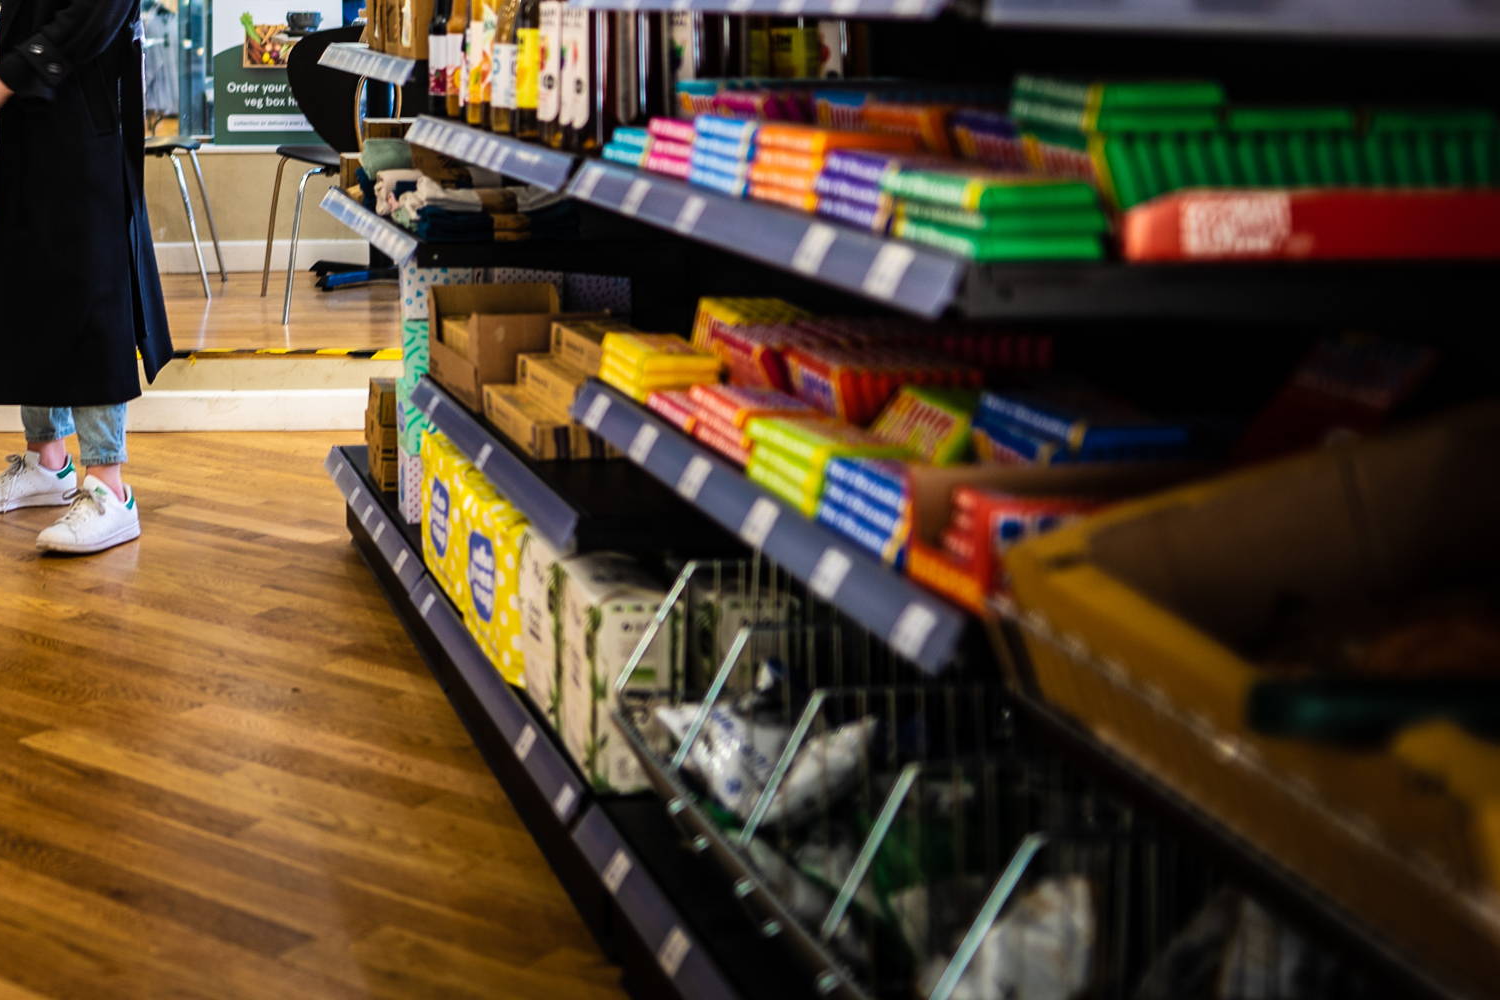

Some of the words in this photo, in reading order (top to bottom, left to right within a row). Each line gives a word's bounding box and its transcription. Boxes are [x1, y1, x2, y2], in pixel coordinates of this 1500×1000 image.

[226, 81, 260, 94] Order
[261, 83, 288, 96] your
[244, 96, 264, 110] veg
[265, 96, 286, 107] box
